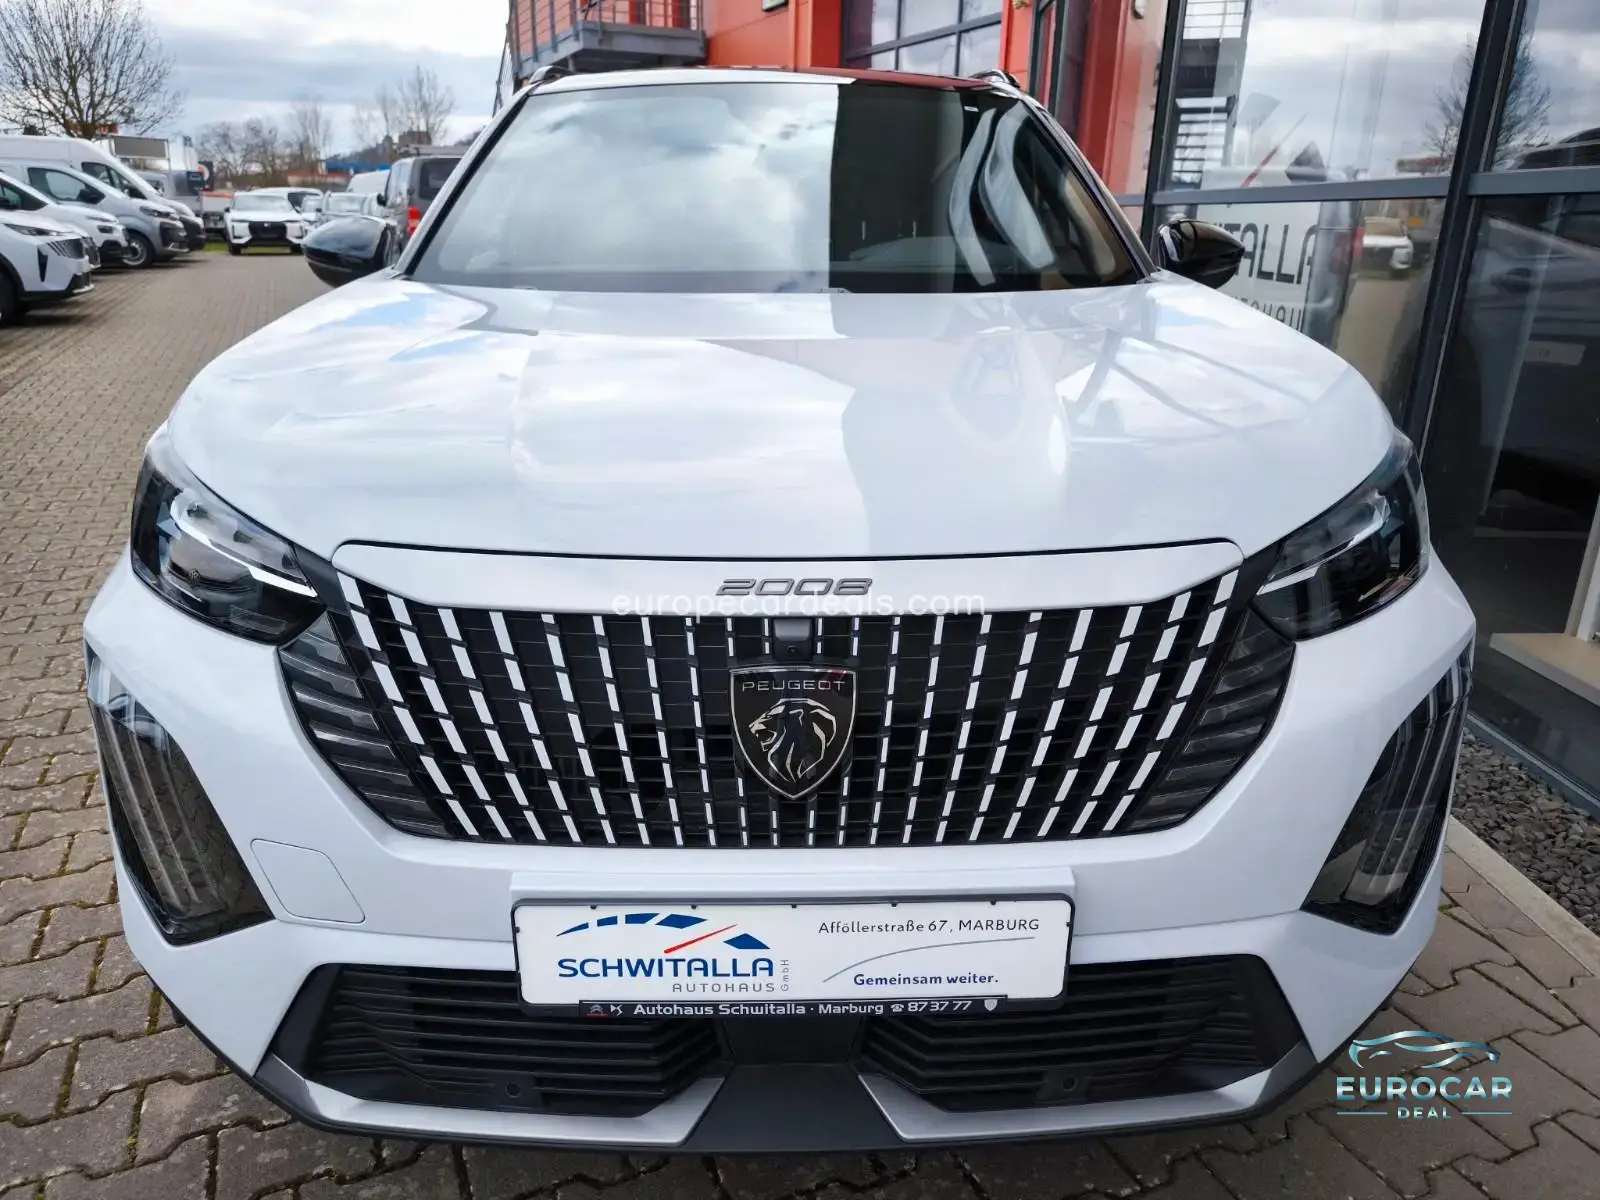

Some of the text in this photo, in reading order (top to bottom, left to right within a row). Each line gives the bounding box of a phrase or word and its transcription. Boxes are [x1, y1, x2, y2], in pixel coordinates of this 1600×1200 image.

[715, 578, 873, 596] 2008
[741, 679, 846, 693] PEUGEOT
[818, 920, 925, 934] Afföllerstraße
[957, 918, 1040, 932] MARBURG
[557, 957, 775, 978] SCHWITALLA
[780, 958, 790, 992] GmbH
[853, 972, 999, 987] Gemeinsam weiter.
[672, 982, 776, 993] AUTOHAUS
[633, 1003, 715, 1016] Autohaus
[718, 1003, 806, 1016] Schwitalla
[817, 1003, 885, 1015] Marburg
